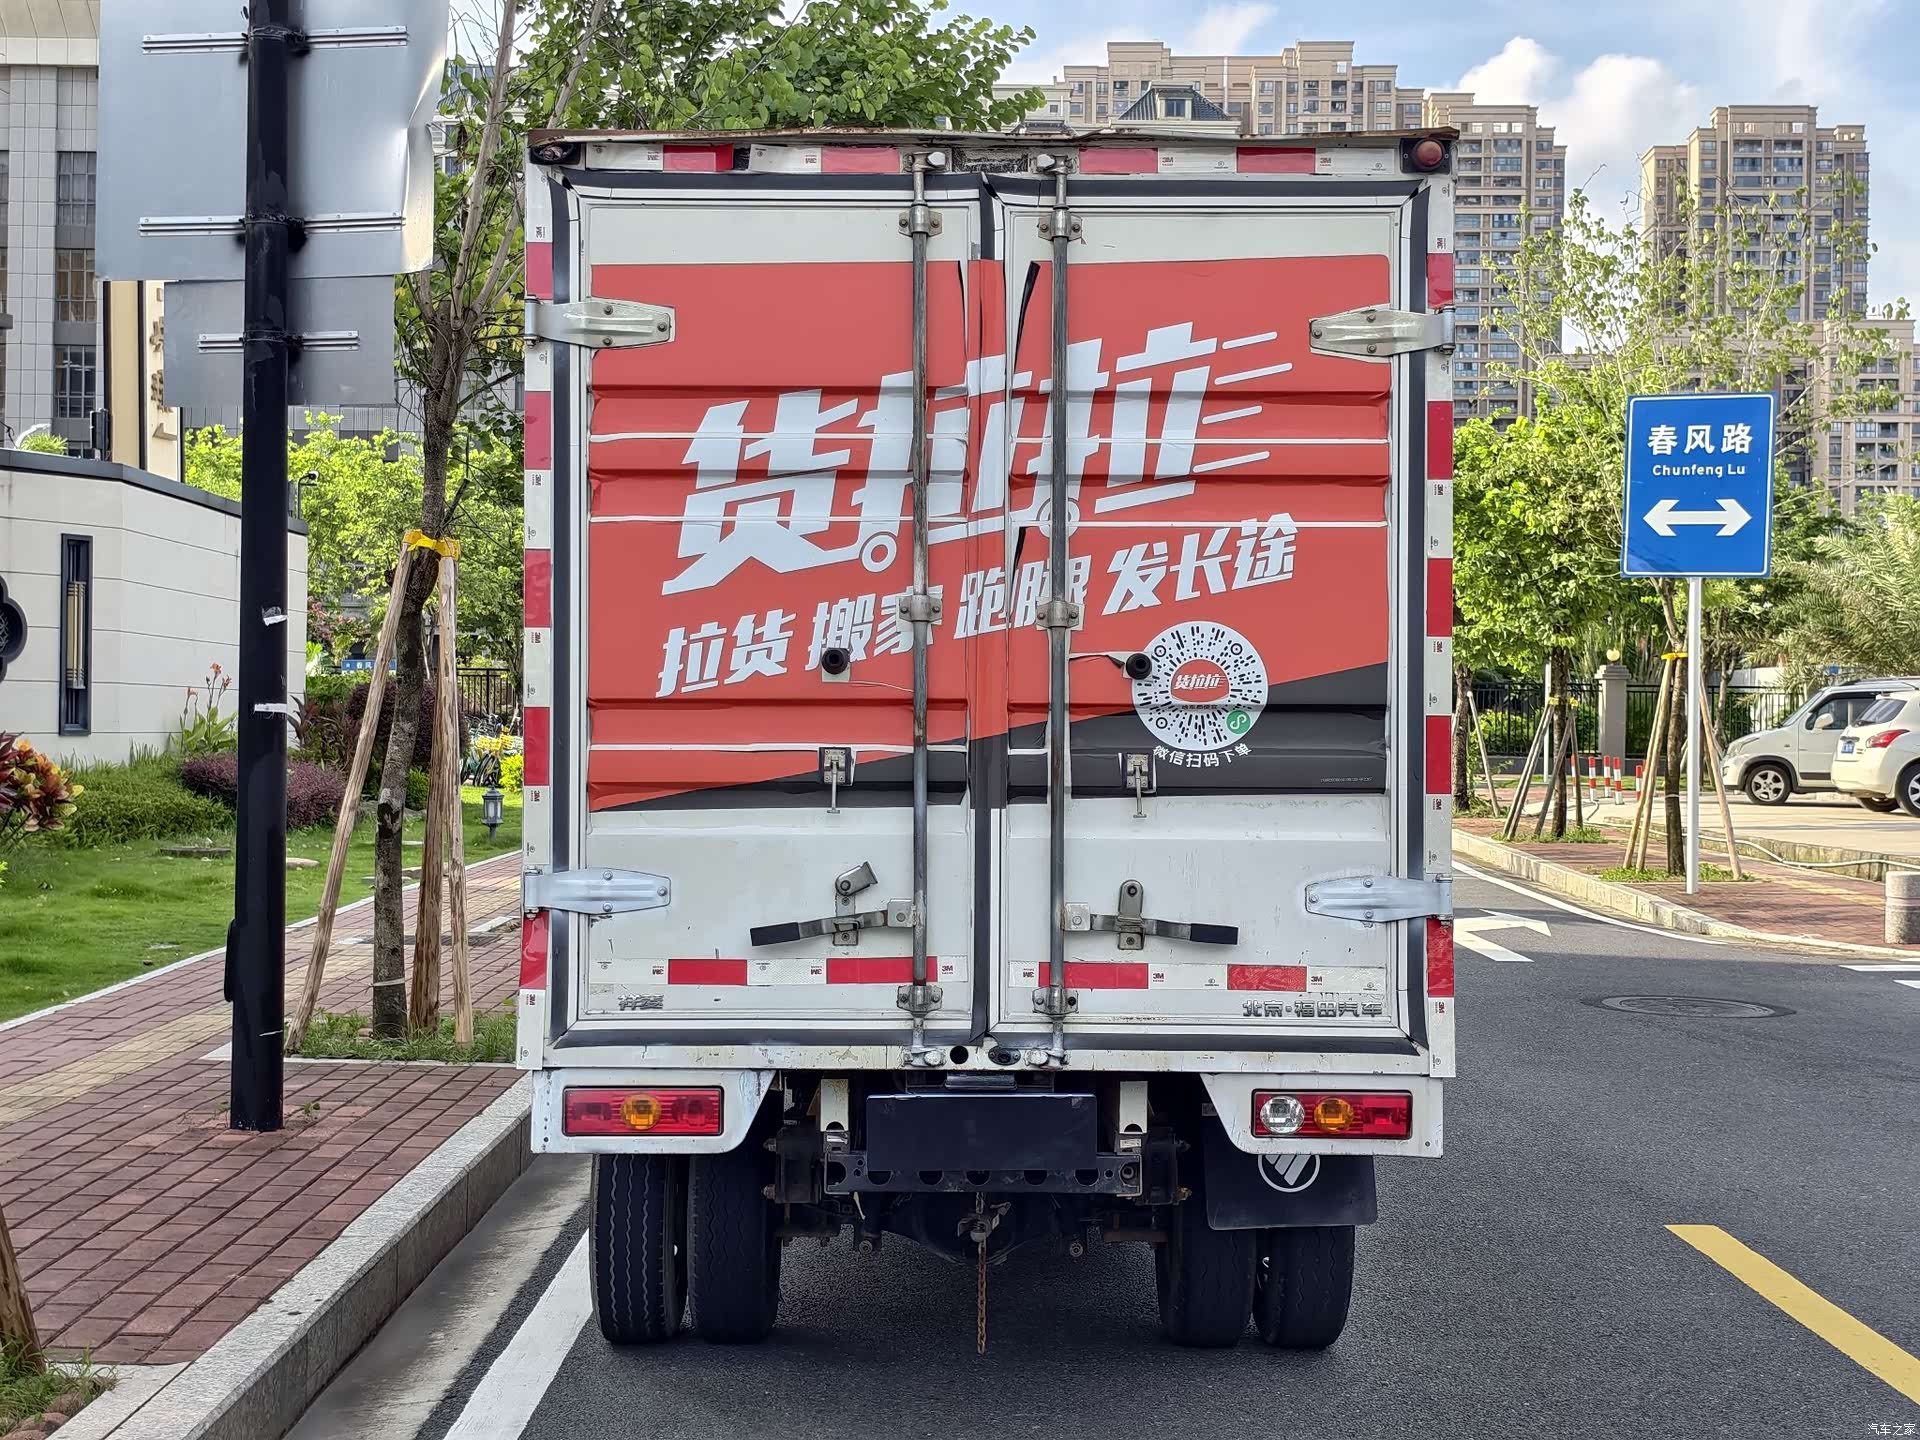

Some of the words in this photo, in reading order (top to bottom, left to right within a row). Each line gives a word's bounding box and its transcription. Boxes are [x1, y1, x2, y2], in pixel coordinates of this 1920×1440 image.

[1647, 424, 1753, 456] 春风路
[662, 322, 1218, 595] 货拉拉
[1652, 464, 1723, 478] Chunfeng
[1727, 463, 1746, 475] Lu
[655, 608, 797, 698] 拉货
[805, 584, 944, 671] 搬家
[1101, 512, 1299, 616] 发长途
[1173, 673, 1221, 691] 货拉拉
[1153, 743, 1252, 768] 微信扫码下单
